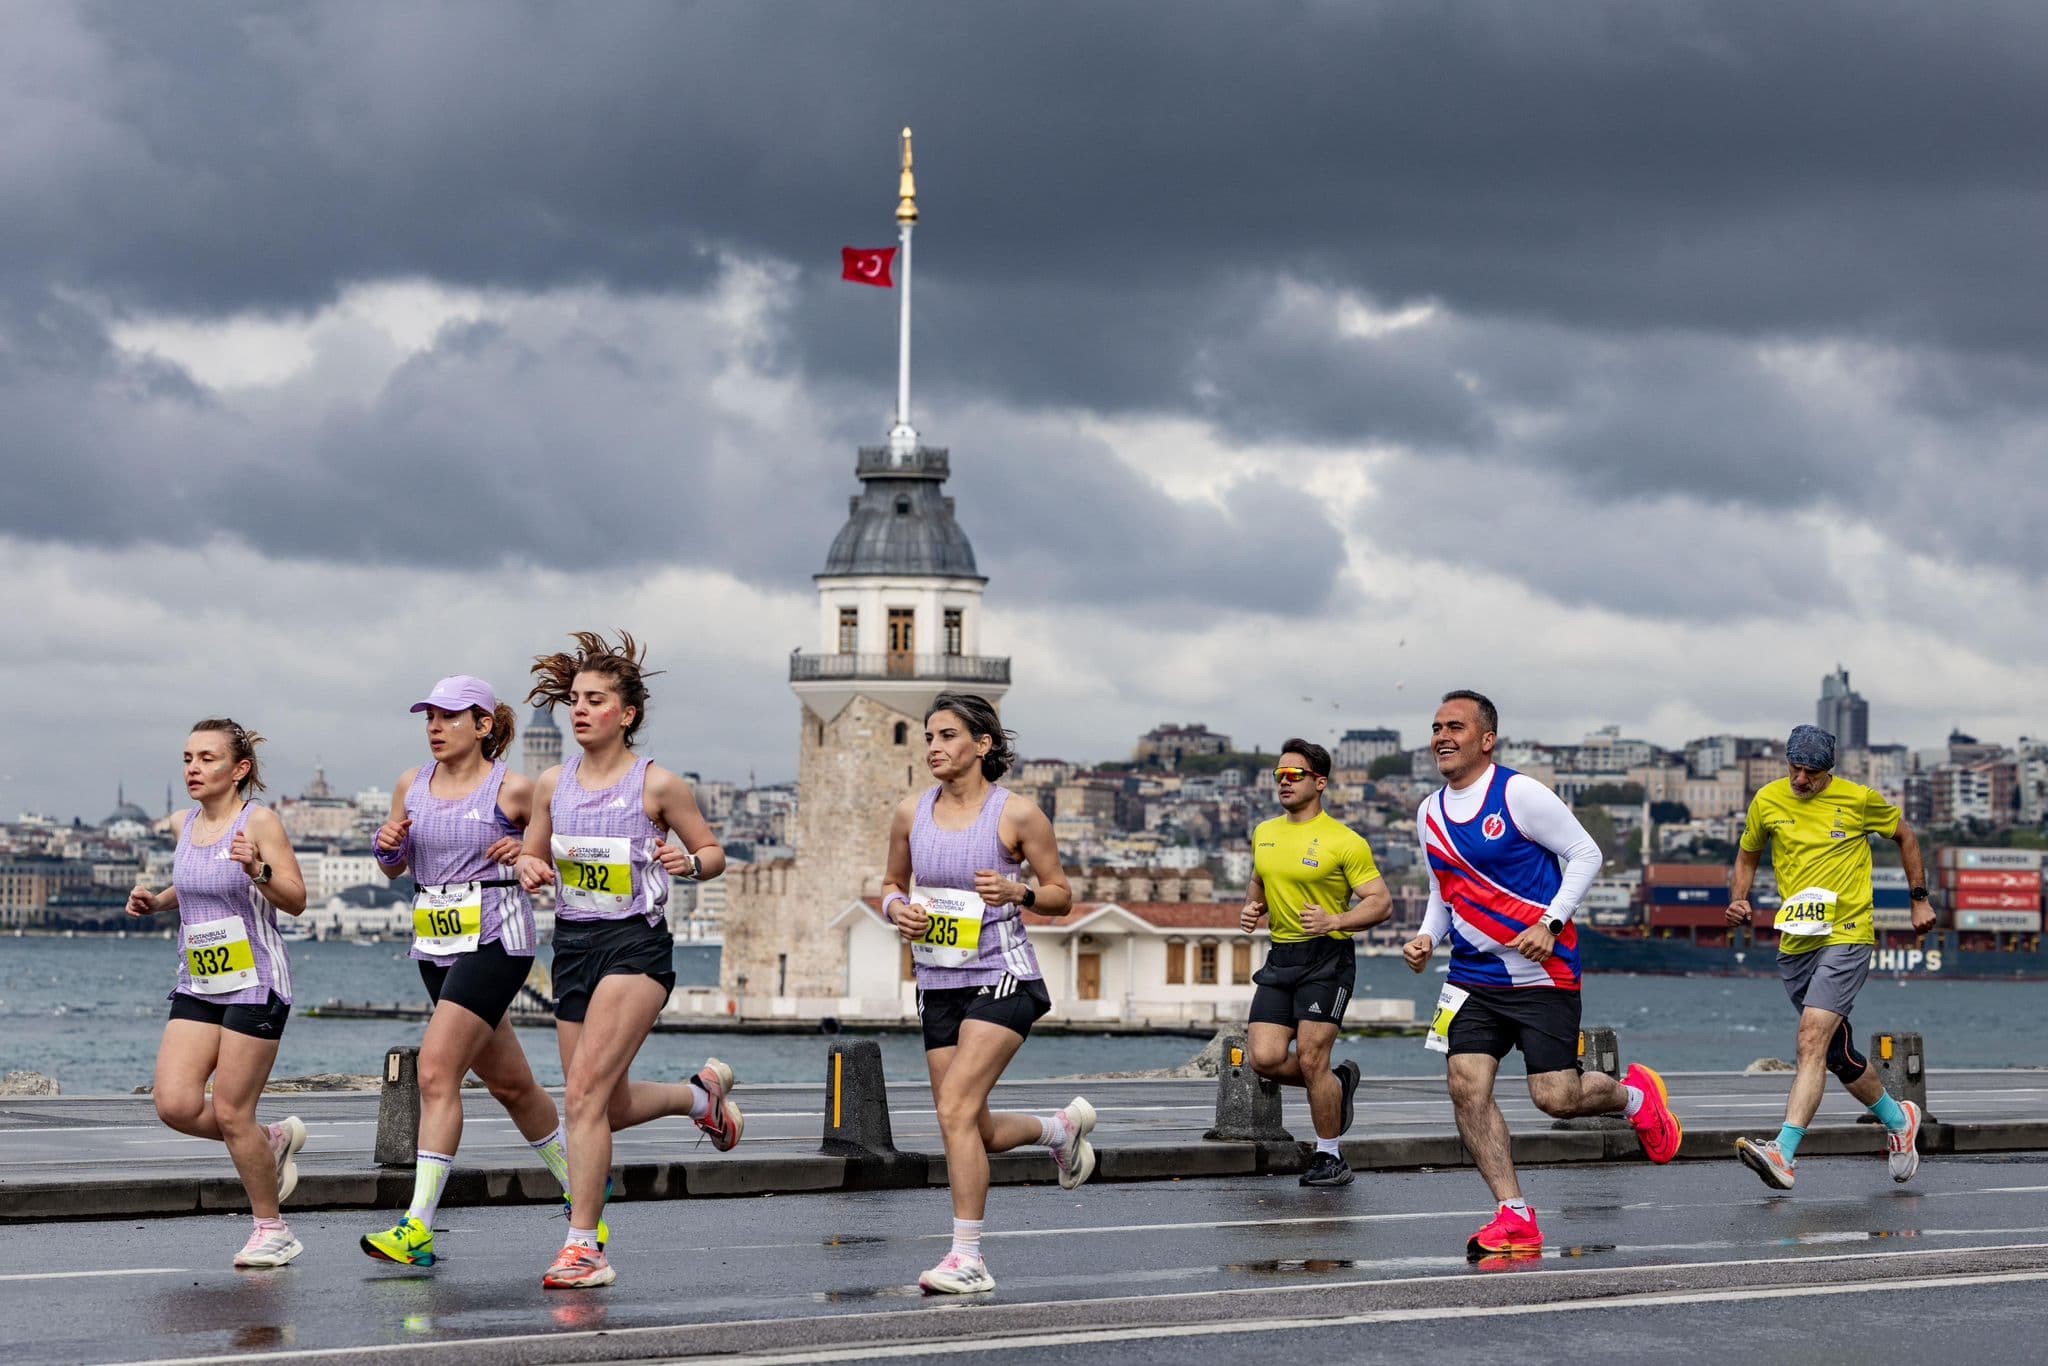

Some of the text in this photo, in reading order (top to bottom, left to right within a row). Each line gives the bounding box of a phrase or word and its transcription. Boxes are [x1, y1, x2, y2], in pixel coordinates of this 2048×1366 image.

[573, 861, 611, 892] 782
[428, 909, 462, 936] 150
[1785, 902, 1825, 922] 2448
[1843, 922, 1857, 930] 10K
[925, 915, 959, 946] 235
[193, 946, 233, 976] 332
